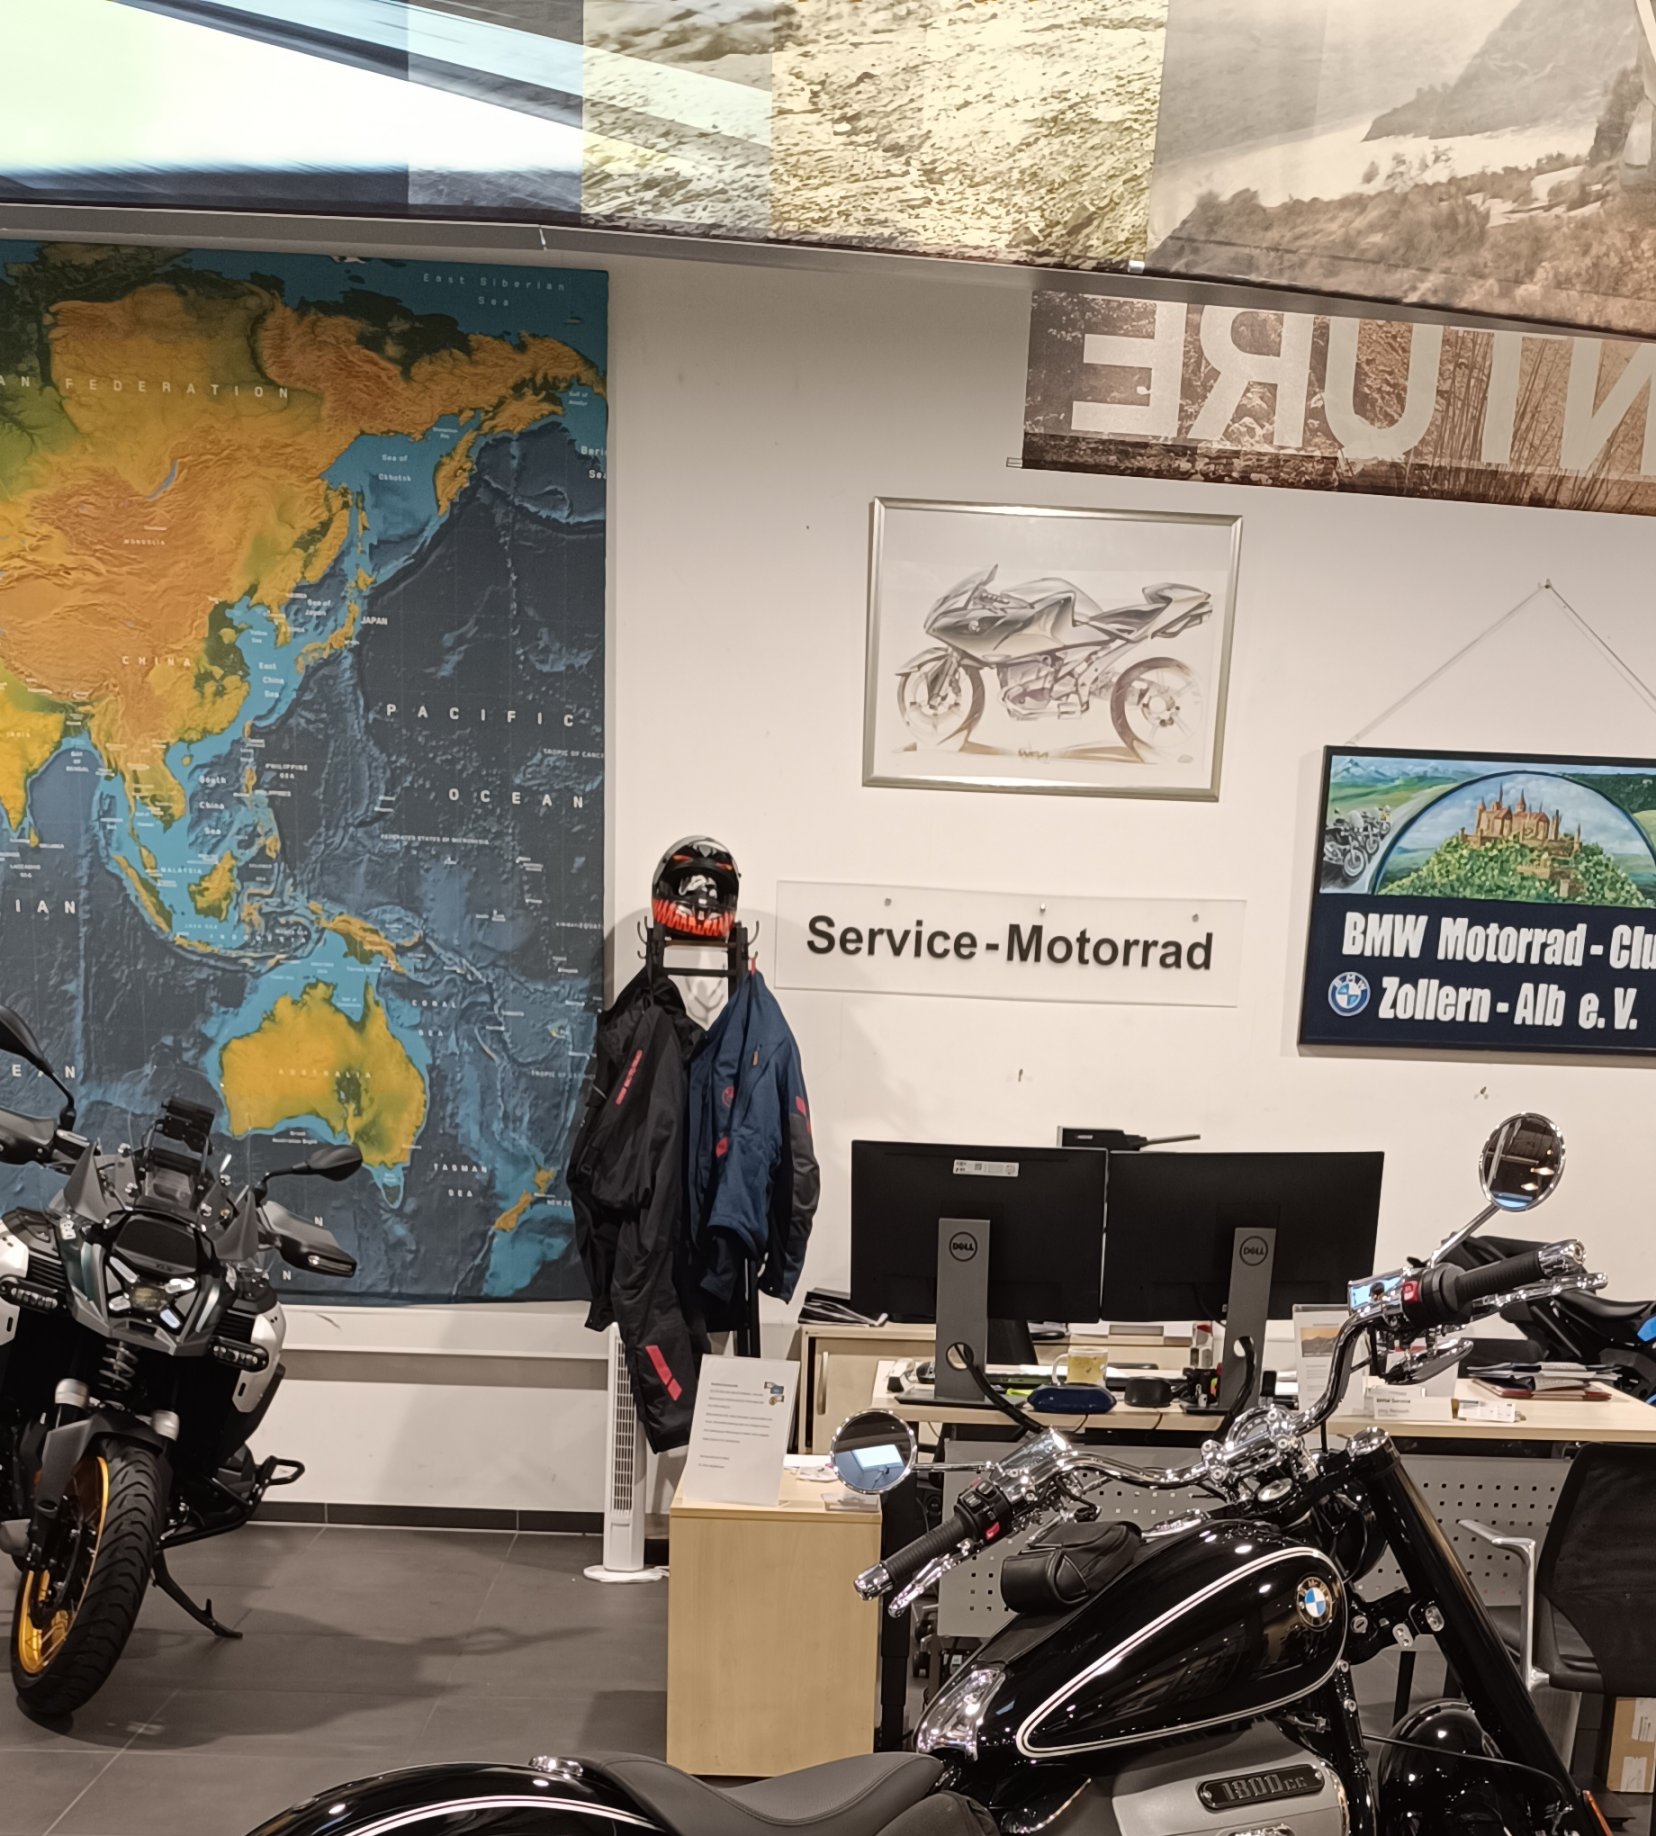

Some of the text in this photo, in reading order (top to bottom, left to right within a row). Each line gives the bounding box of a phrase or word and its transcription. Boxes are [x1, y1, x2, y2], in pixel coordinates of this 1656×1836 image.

[423, 273, 565, 291] East Siberian
[478, 296, 510, 307] Sea
[65, 378, 289, 400] FEDERATION
[361, 616, 388, 626] JAPAN
[122, 656, 192, 668] CHINA
[386, 704, 575, 727] PACIFIC
[448, 787, 584, 809] OCEAN
[1342, 911, 1429, 958] BMW
[411, 999, 457, 1009] CORAL
[433, 1163, 488, 1174] TASMAN
[953, 1242, 974, 1251] DELL
[1244, 1247, 1265, 1256] DELL
